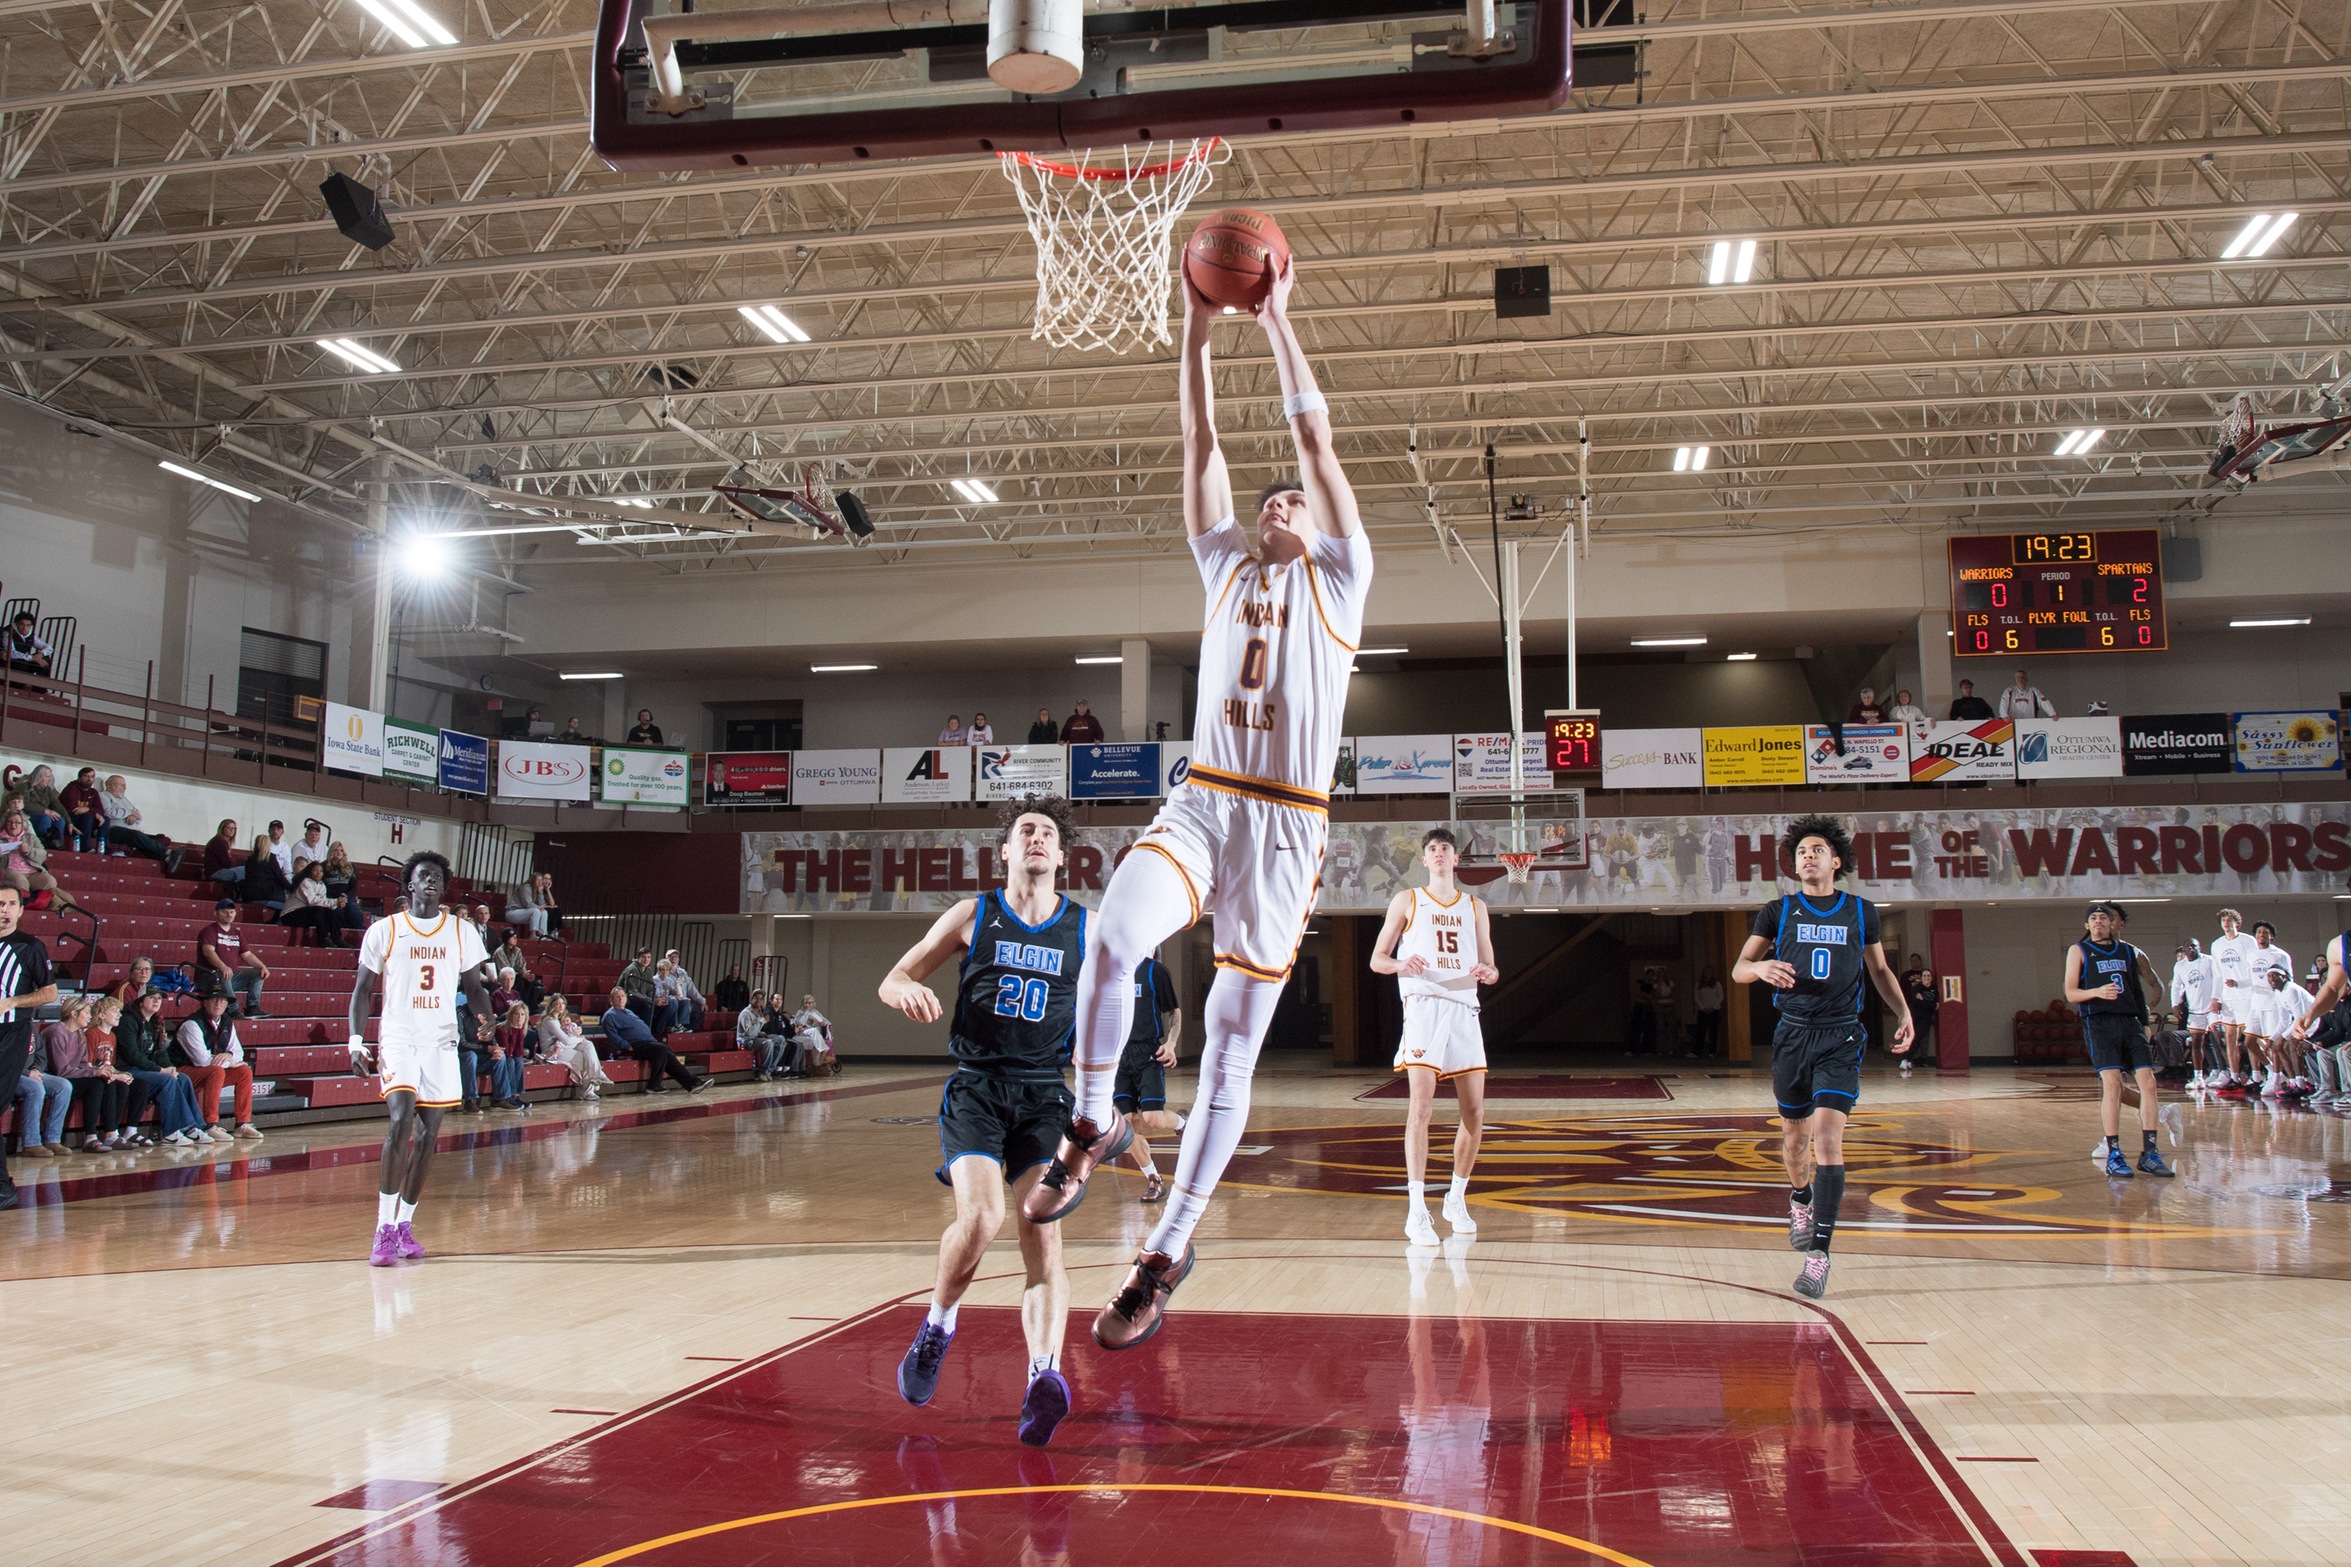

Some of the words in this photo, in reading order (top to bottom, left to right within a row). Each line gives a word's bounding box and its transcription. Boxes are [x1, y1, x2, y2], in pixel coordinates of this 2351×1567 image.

[2026, 535, 2092, 560] 19:23
[1959, 567, 2014, 581] WARRIORS
[2041, 572, 2071, 581] PERIOD
[2097, 563, 2153, 576] SPARTANS
[1991, 583, 2007, 607] 0
[2058, 584, 2064, 601] 1
[2133, 578, 2148, 602] 2
[1967, 614, 1989, 626] FLS
[2000, 615, 2023, 624] T.O.L.
[2028, 612, 2057, 624] PLYR
[2063, 611, 2091, 623] FOUL
[2095, 612, 2118, 622] T.O.L.
[2130, 609, 2151, 621] FLS
[1976, 630, 1989, 650] 0
[2006, 629, 2018, 649] 6
[2101, 626, 2114, 646] 6
[2138, 625, 2151, 645] 0
[1239, 637, 1268, 691] 0
[1224, 698, 1275, 731] HILLS
[1554, 723, 1595, 738] 19:23
[2241, 729, 2285, 740] Sassy
[327, 737, 345, 750] Iowa
[346, 740, 363, 754] State
[364, 743, 381, 757] Bank
[387, 735, 436, 758] RICHWELL
[1478, 737, 1524, 746] RE/M
[1705, 738, 1756, 753] Edward
[1758, 738, 1801, 752] Jones
[2057, 735, 2111, 744] OTTUMWA
[2129, 730, 2223, 749] Mediacom
[2254, 740, 2335, 750] Sunflower
[391, 748, 408, 759] CARPET
[1556, 739, 1589, 766] 27
[1928, 742, 2004, 758] IDEAL
[2050, 744, 2120, 754] REGIONAL
[402, 759, 420, 768] CENTER
[517, 759, 570, 776] JBS
[1358, 755, 1392, 770] Polar
[1602, 752, 1662, 774] Success
[1664, 752, 1697, 765] BANK
[3, 765, 22, 791] G
[629, 774, 650, 784] Quality
[651, 776, 663, 784] gas.
[796, 767, 835, 779] GREGG
[838, 767, 877, 778] YOUNG
[1091, 769, 1140, 778] Accelerate.
[607, 780, 630, 788] Trusted
[654, 782, 666, 790] 100
[666, 784, 683, 792] years.
[904, 781, 931, 789] Anderson,
[989, 781, 1053, 791] 641-684-6302
[374, 812, 398, 822] STUDENT
[400, 816, 421, 826] SECTION
[391, 823, 403, 844] H
[1941, 831, 1980, 852] OF
[2009, 822, 2351, 877] WARRIORS
[775, 848, 872, 893] THE
[882, 846, 1100, 892] HELLR
[1934, 856, 1989, 878] THE
[1432, 914, 1462, 927] INDIAN
[1797, 923, 1848, 945] ELGIN
[1436, 930, 1459, 954] 15
[410, 946, 446, 960] INDIAN
[993, 940, 1064, 976] ELGIN
[1437, 956, 1461, 970] HILLS
[1811, 948, 1831, 979] 0
[2095, 959, 2127, 974] ELGIN
[420, 965, 435, 991] 3
[2110, 973, 2125, 994] 3
[412, 996, 440, 1009] HILLS
[994, 974, 1049, 1022] 20
